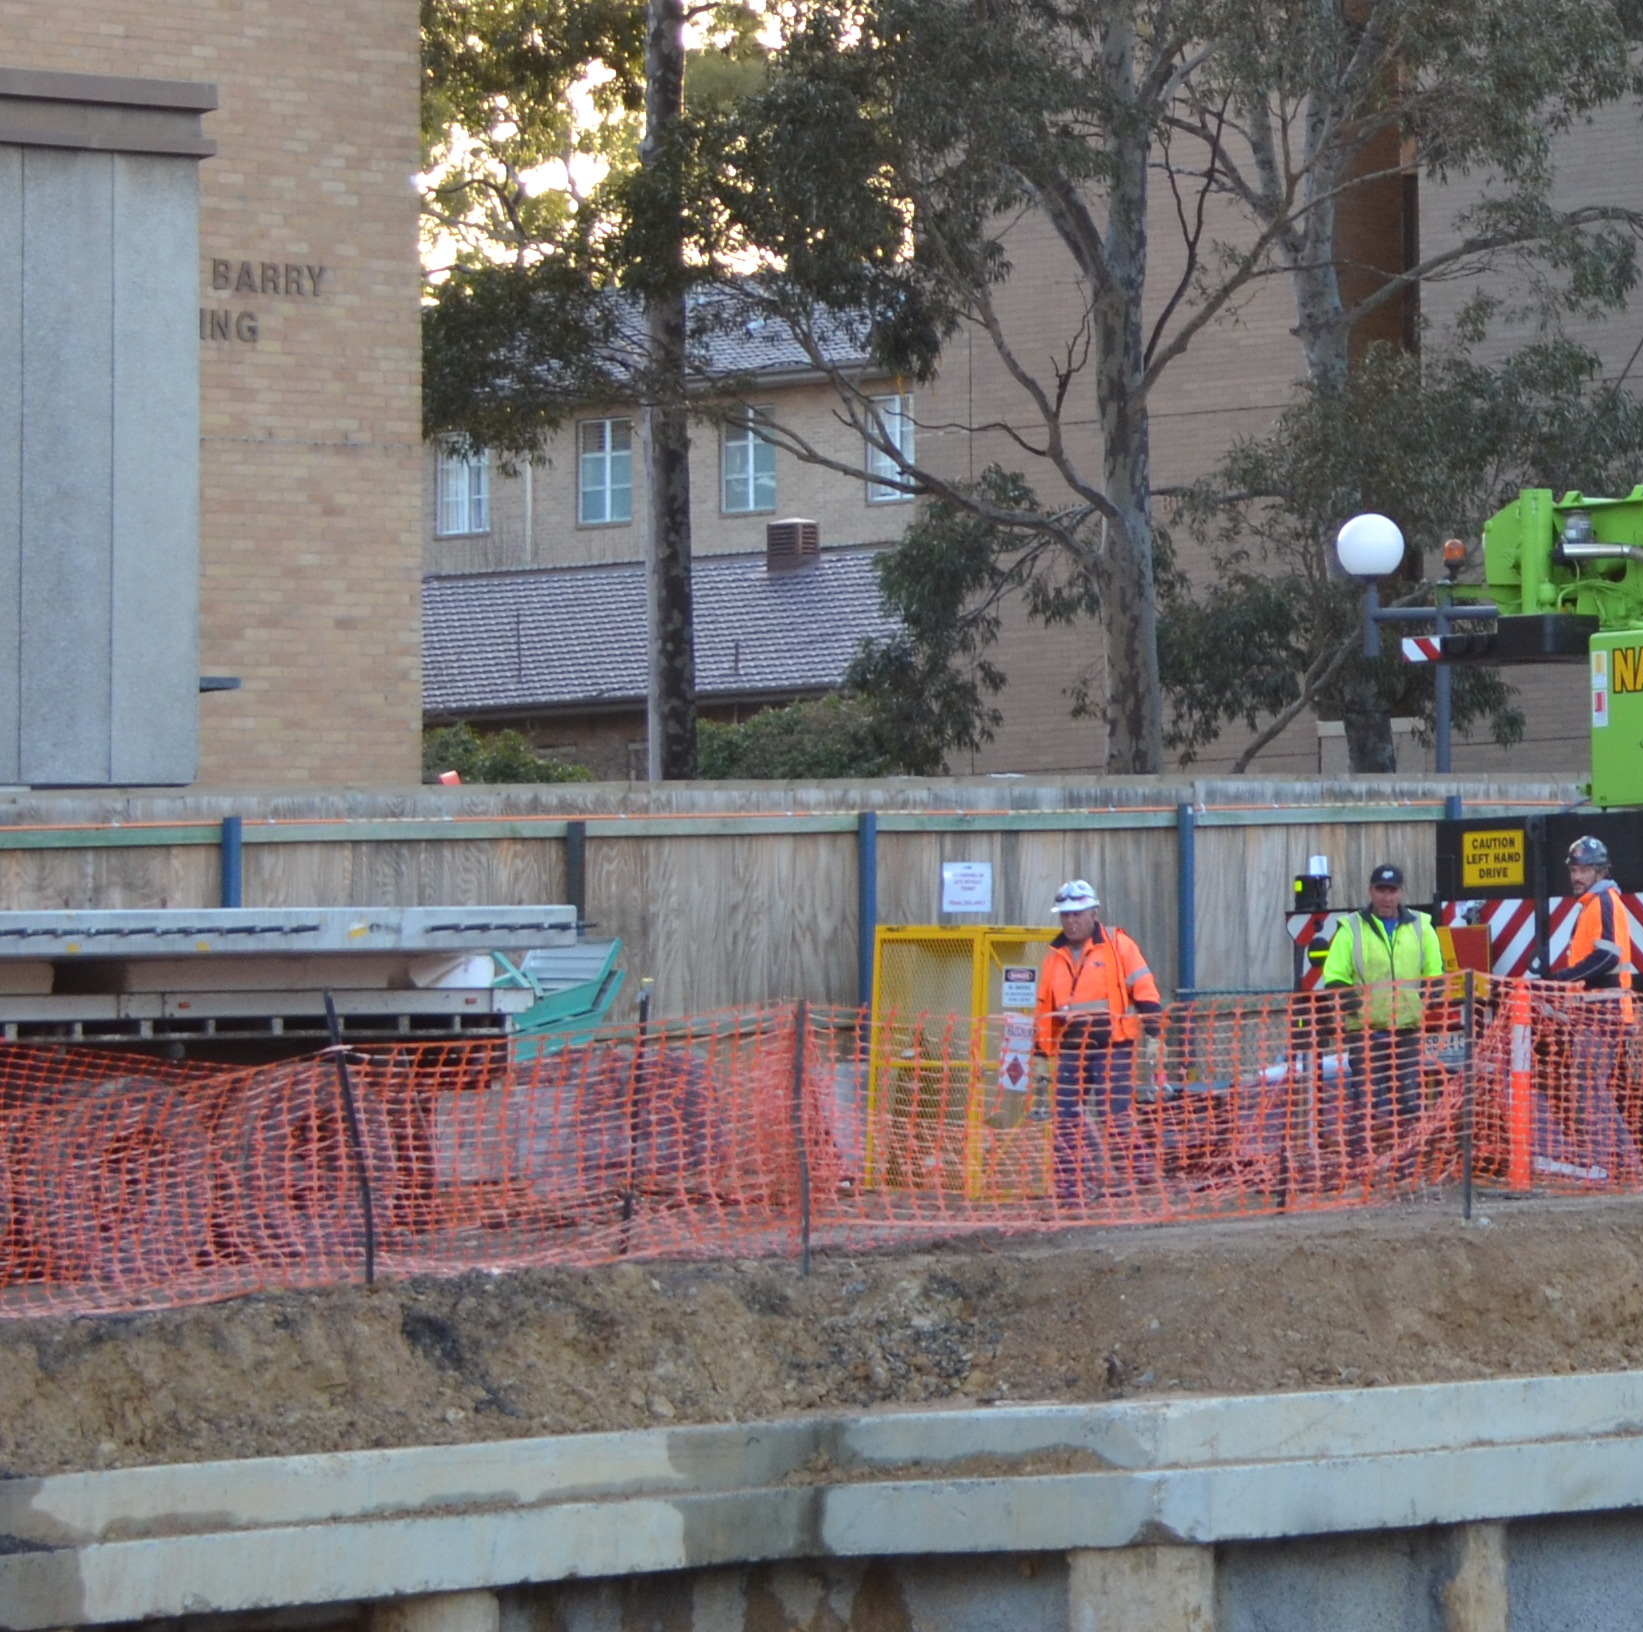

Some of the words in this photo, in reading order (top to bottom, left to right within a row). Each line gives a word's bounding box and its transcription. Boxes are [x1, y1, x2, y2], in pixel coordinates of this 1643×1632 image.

[212, 257, 326, 297] BARRY
[1471, 837, 1516, 850] CAUTION
[1466, 852, 1490, 865] LEFT
[1493, 852, 1521, 864] HAND
[1478, 867, 1509, 879] DRIVE
